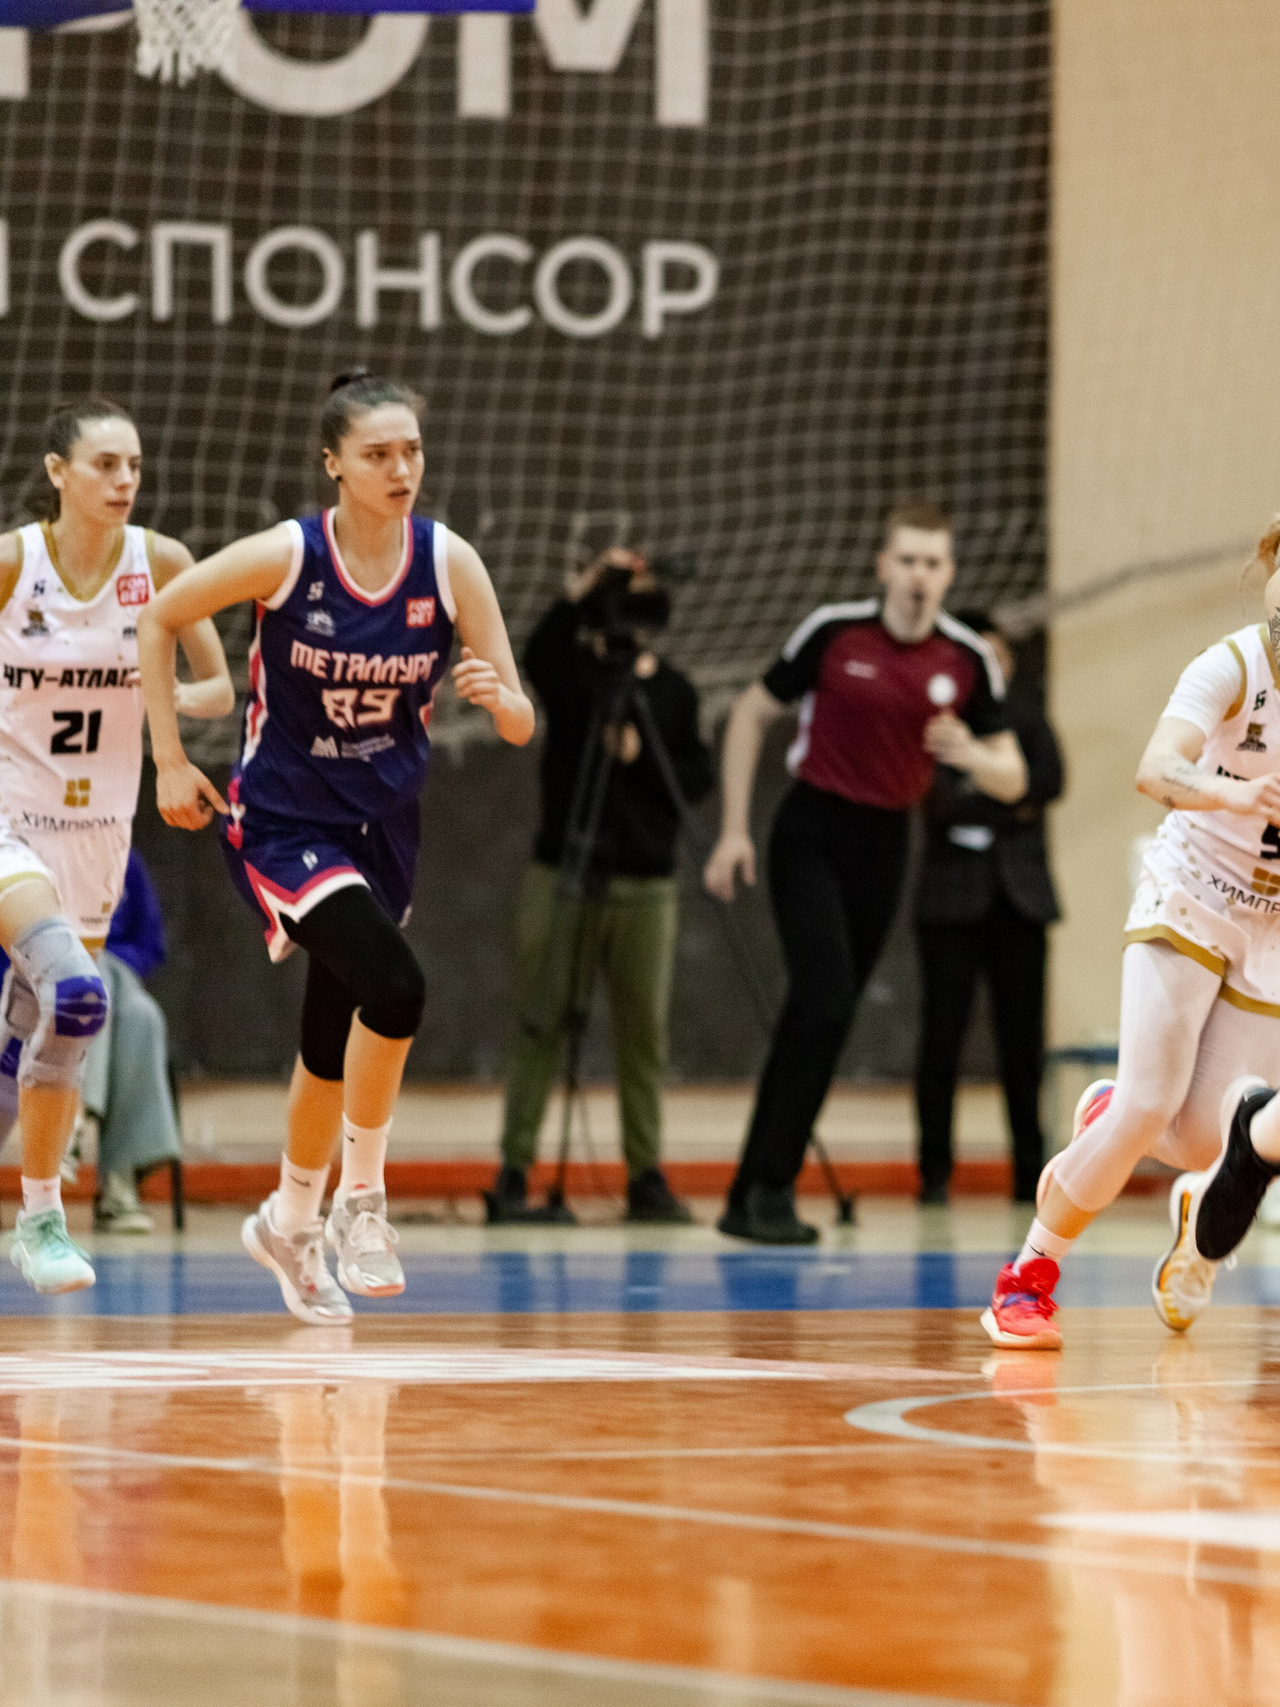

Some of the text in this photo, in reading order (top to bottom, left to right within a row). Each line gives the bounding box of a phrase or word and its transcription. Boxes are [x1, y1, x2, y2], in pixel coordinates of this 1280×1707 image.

[59, 219, 720, 339] СПОНСОР
[290, 639, 439, 684] МЕТАЛЛУРГ
[50, 710, 102, 755] 21
